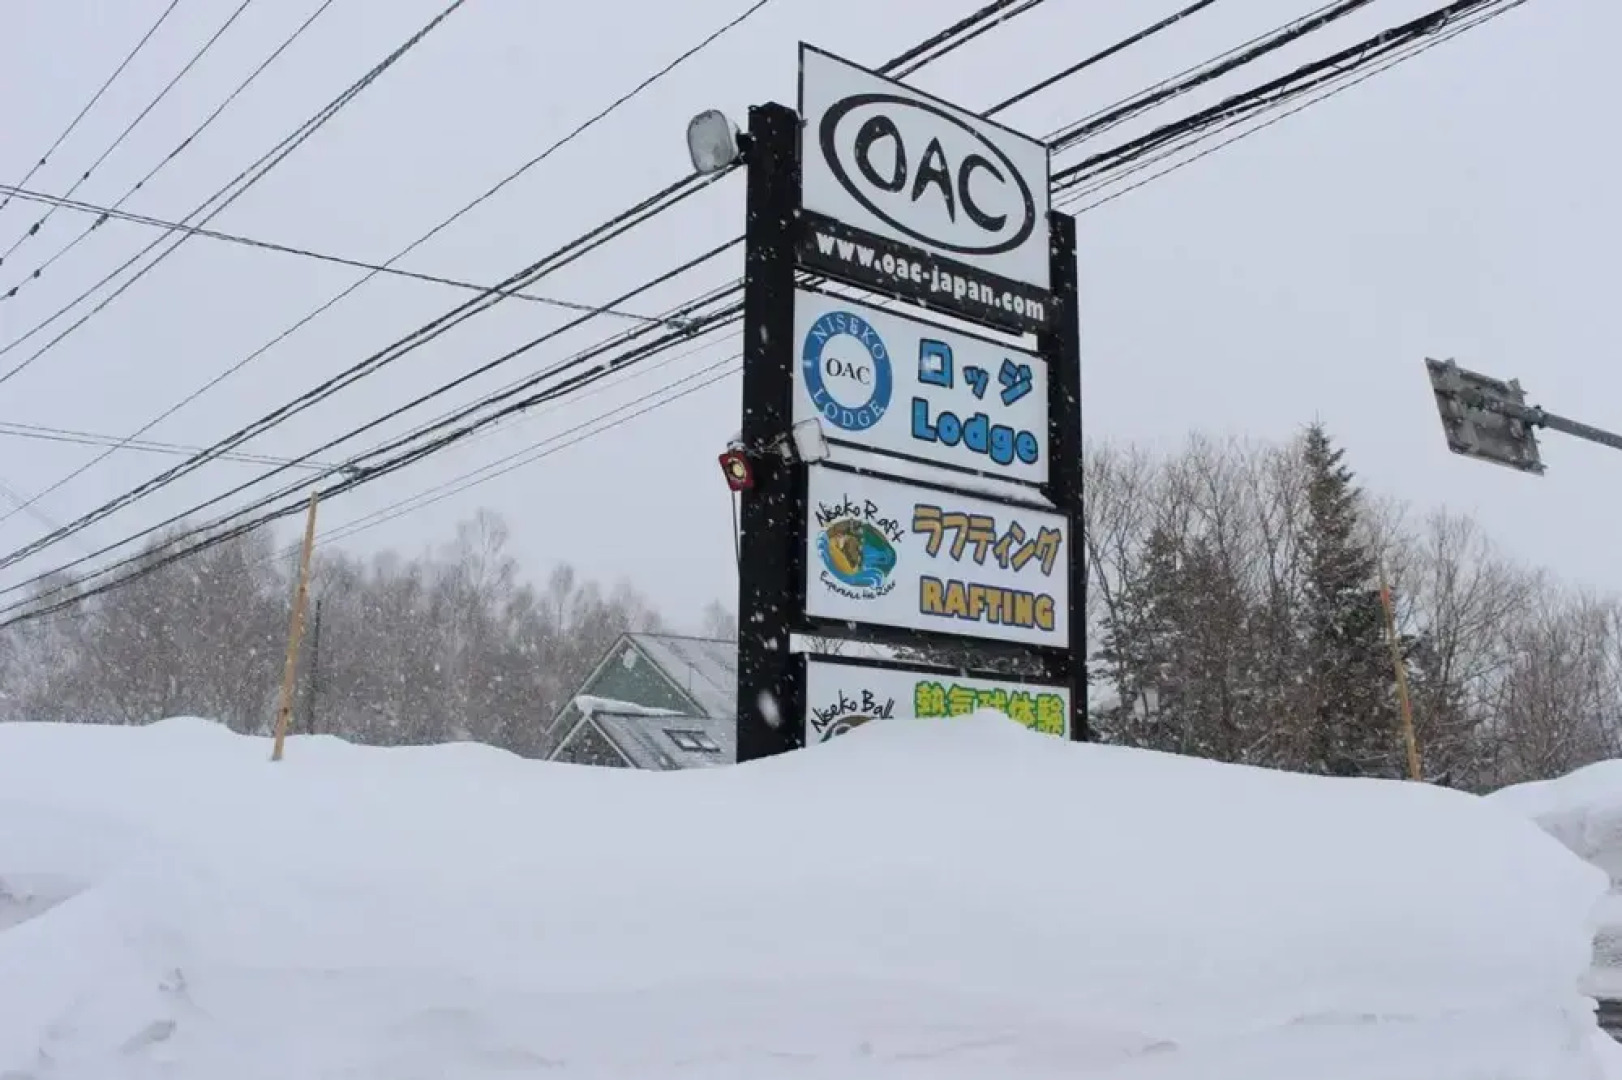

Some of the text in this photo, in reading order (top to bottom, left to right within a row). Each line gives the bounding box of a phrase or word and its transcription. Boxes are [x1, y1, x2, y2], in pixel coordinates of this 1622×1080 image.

[854, 114, 1008, 232] OAC
[815, 233, 1045, 322] www.oac-japan.com
[811, 314, 885, 359] NISEKO
[825, 358, 871, 385] OAC
[918, 338, 1033, 406] ロッジ
[813, 388, 885, 427] LODGE
[912, 397, 1039, 465] Lodge
[912, 503, 1062, 577] ラフティング
[920, 575, 1054, 631] RAFTING
[811, 688, 858, 733] Niseko
